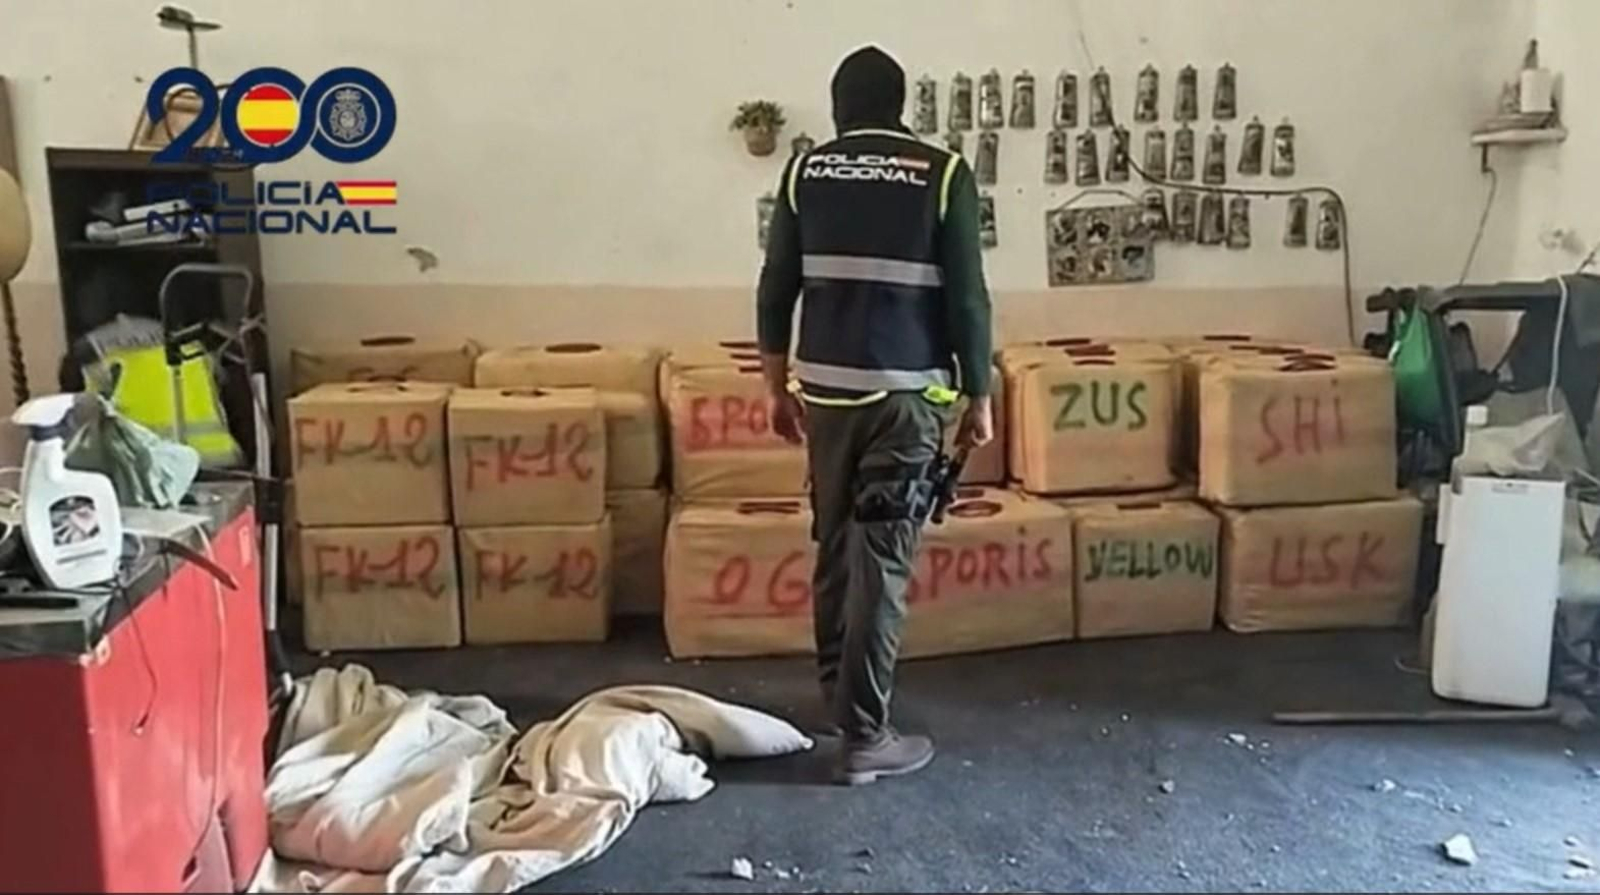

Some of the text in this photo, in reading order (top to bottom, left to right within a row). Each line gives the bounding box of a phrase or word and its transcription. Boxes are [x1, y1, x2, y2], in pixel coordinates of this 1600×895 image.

[803, 166, 927, 186] NACIONAL
[806, 154, 900, 167] POLICIA
[1049, 380, 1147, 432] ZUS
[1084, 540, 1214, 582] YELLOW
[1270, 531, 1387, 590] USK
